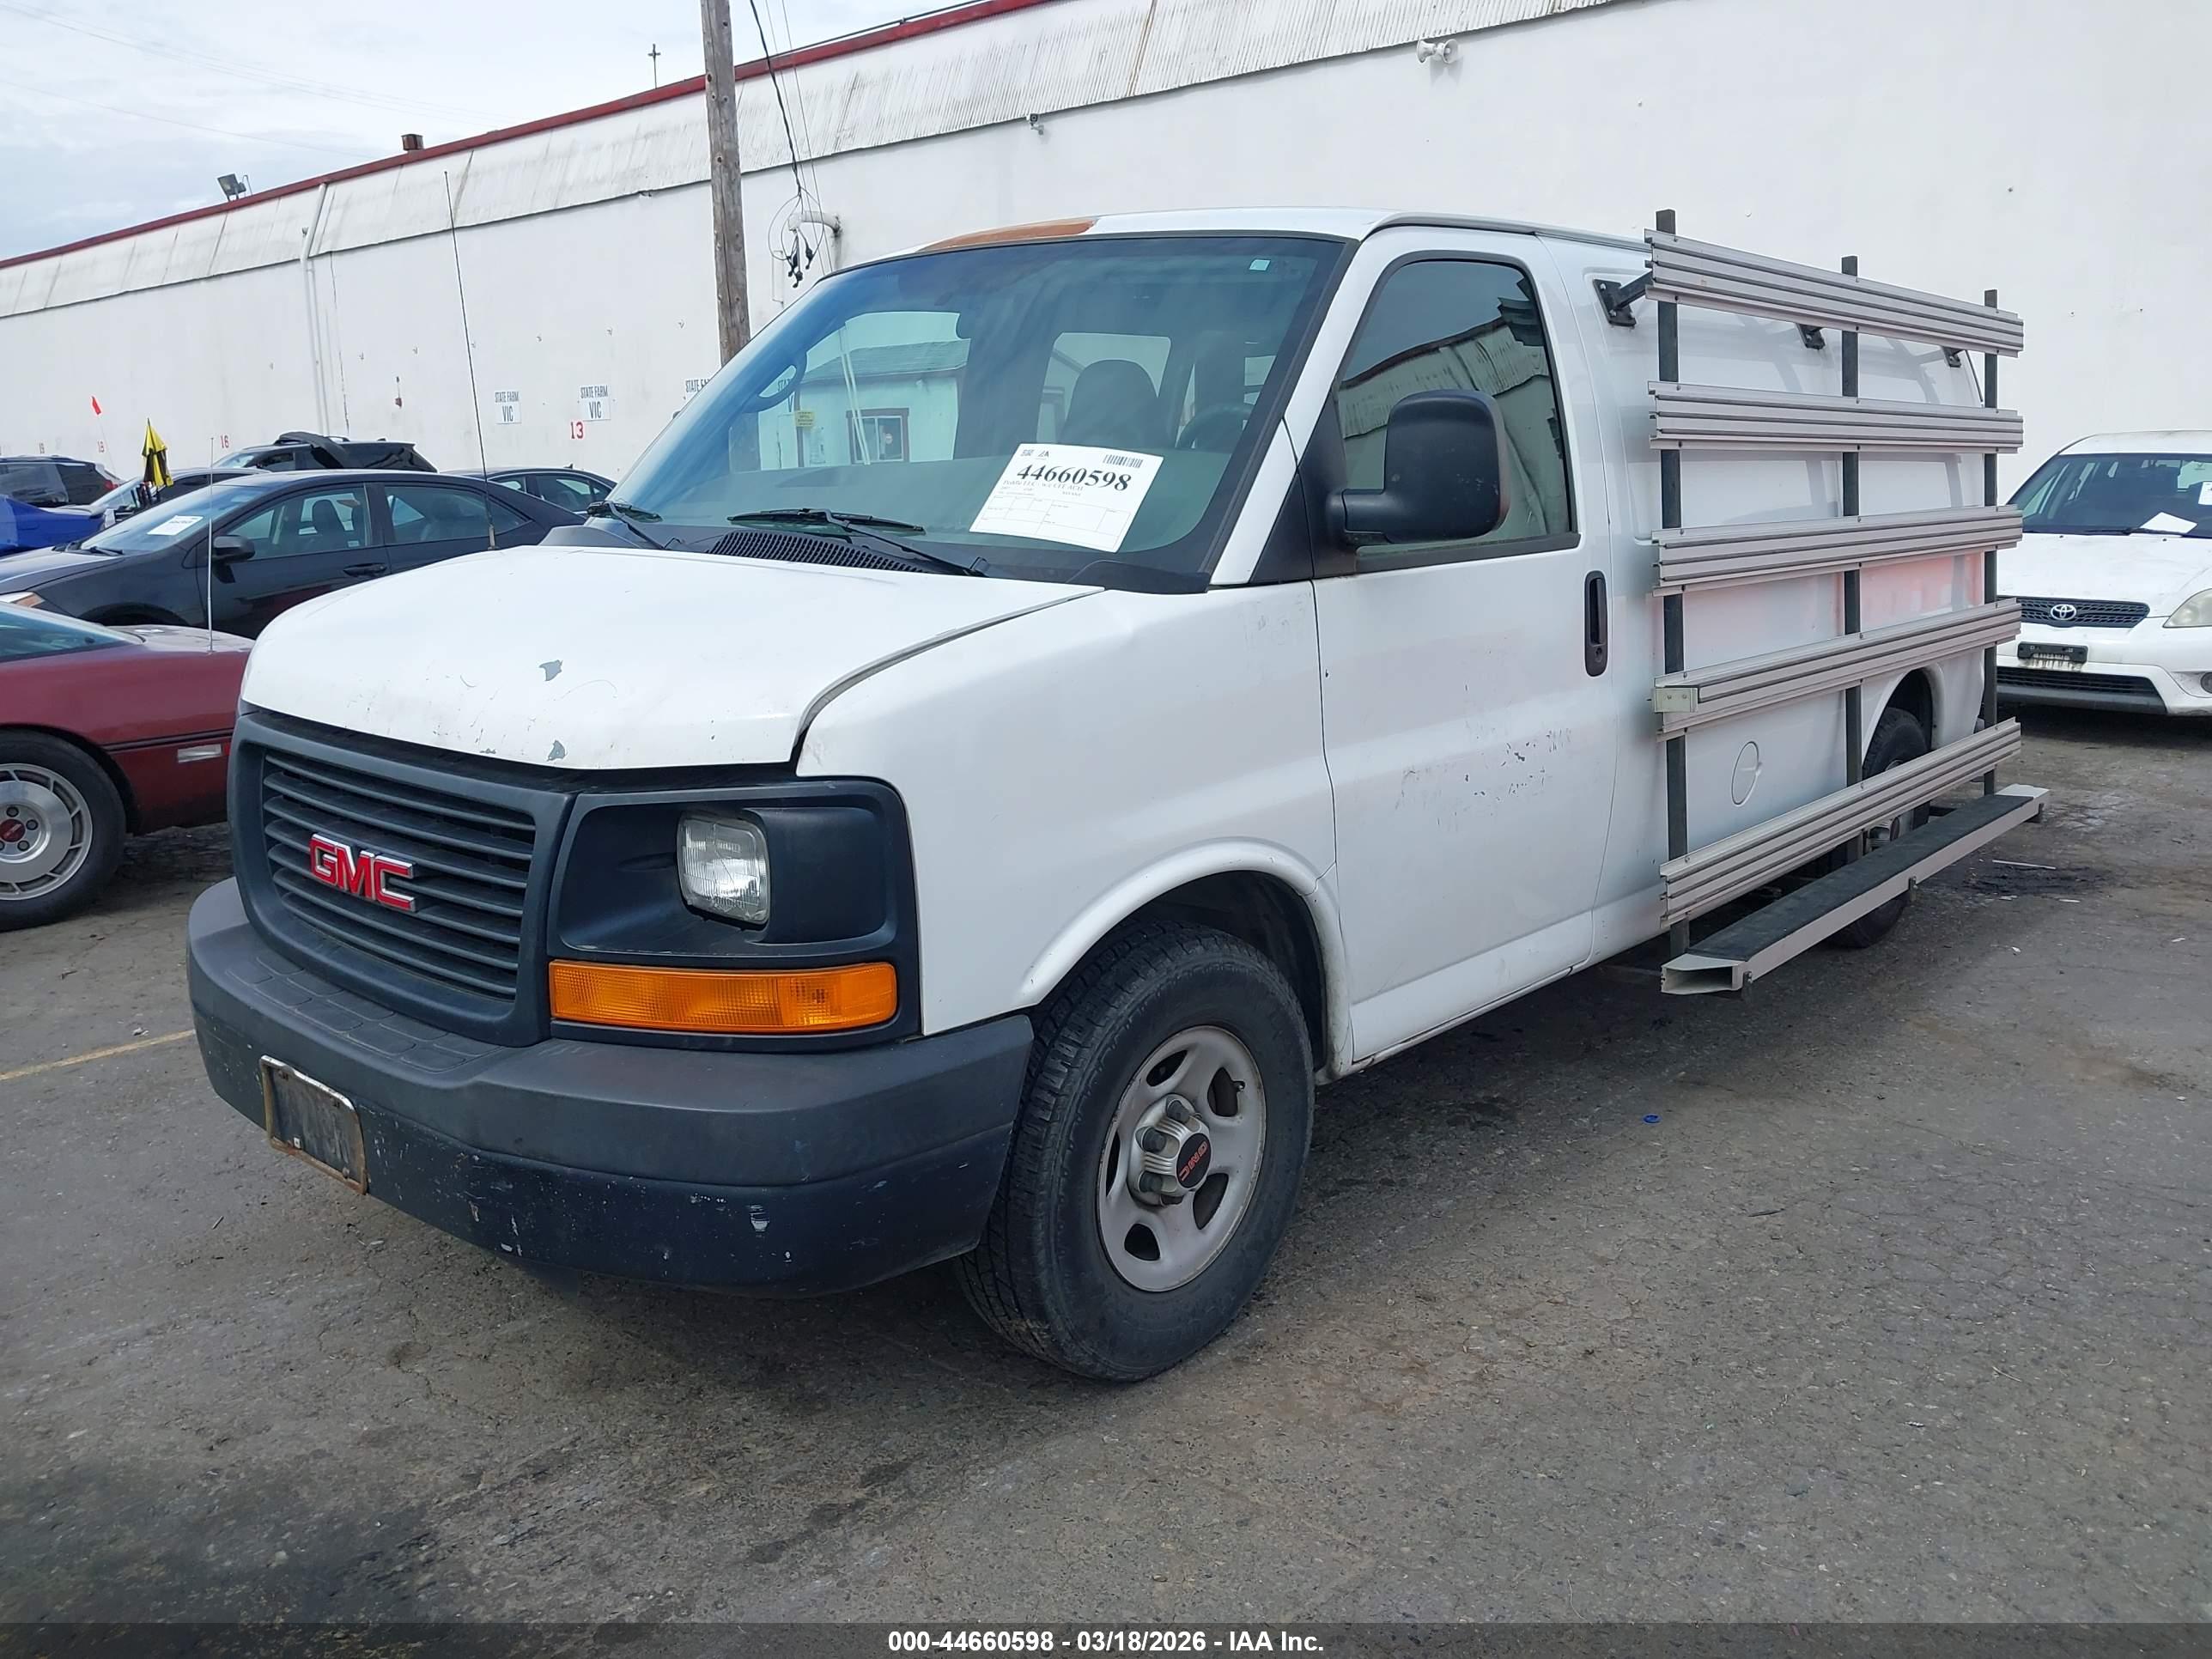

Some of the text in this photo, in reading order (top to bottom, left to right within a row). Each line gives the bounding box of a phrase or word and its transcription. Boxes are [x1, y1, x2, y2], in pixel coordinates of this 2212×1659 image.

[495, 391, 520, 403] STATE FARM
[580, 385, 608, 399] STATE FARM
[502, 405, 514, 422] VIC
[588, 401, 602, 419] VIC
[570, 422, 584, 440] 13
[220, 434, 229, 448] 16
[1017, 464, 1132, 491] 44660598
[309, 833, 416, 912] GMC
[1179, 1141, 1208, 1182] GMC
